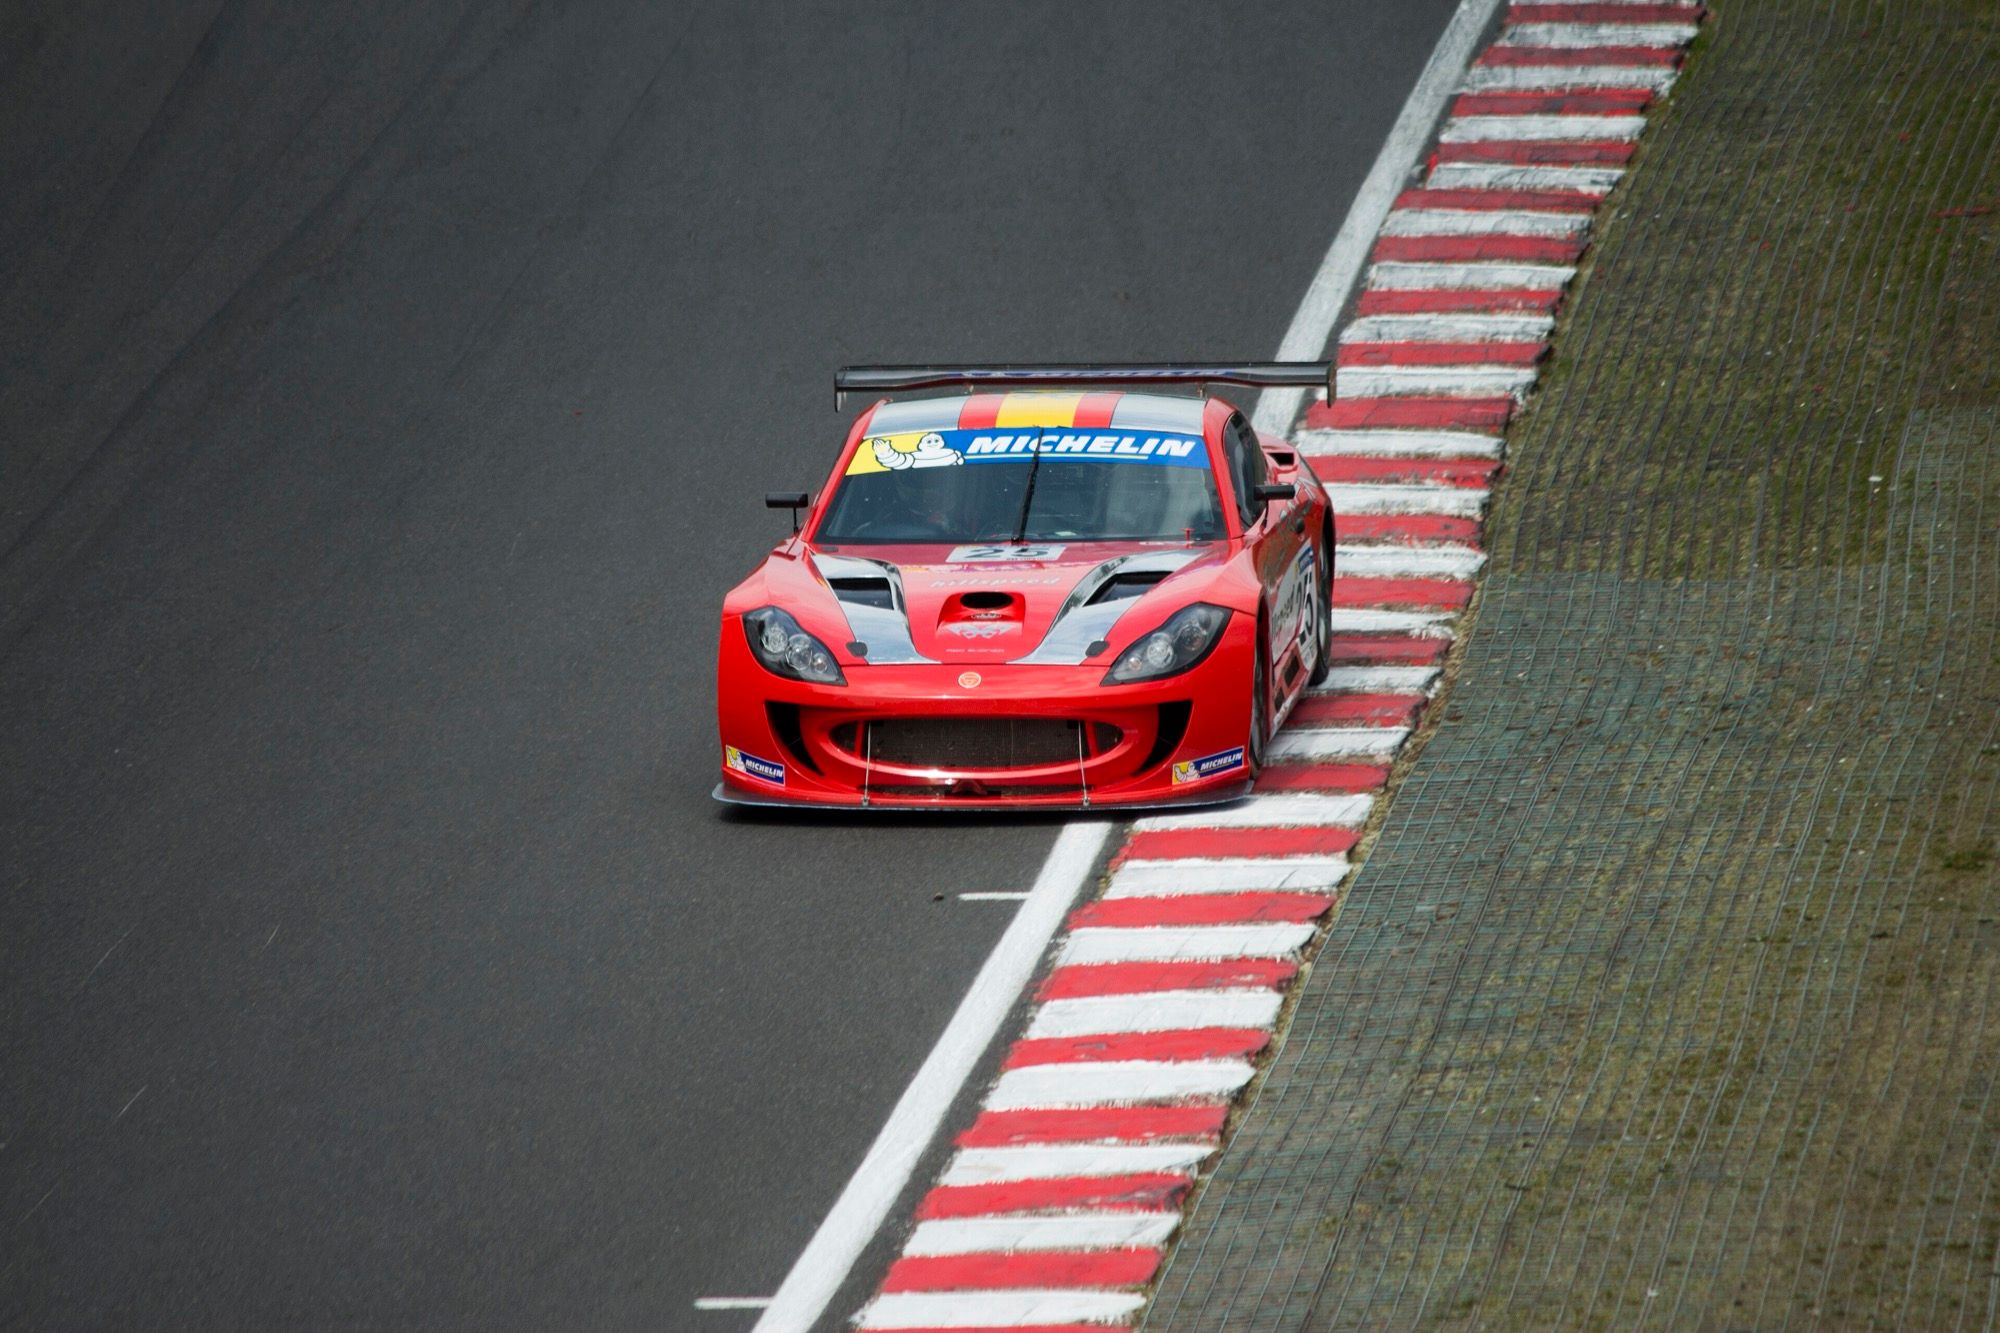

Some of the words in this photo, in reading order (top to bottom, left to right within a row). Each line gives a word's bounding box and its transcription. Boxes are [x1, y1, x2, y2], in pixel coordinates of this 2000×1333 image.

[966, 435, 1196, 457] MICHELIN
[964, 547, 1049, 559] 25
[745, 759, 784, 778] MICHELIN
[1200, 752, 1243, 771] MICHELIN
